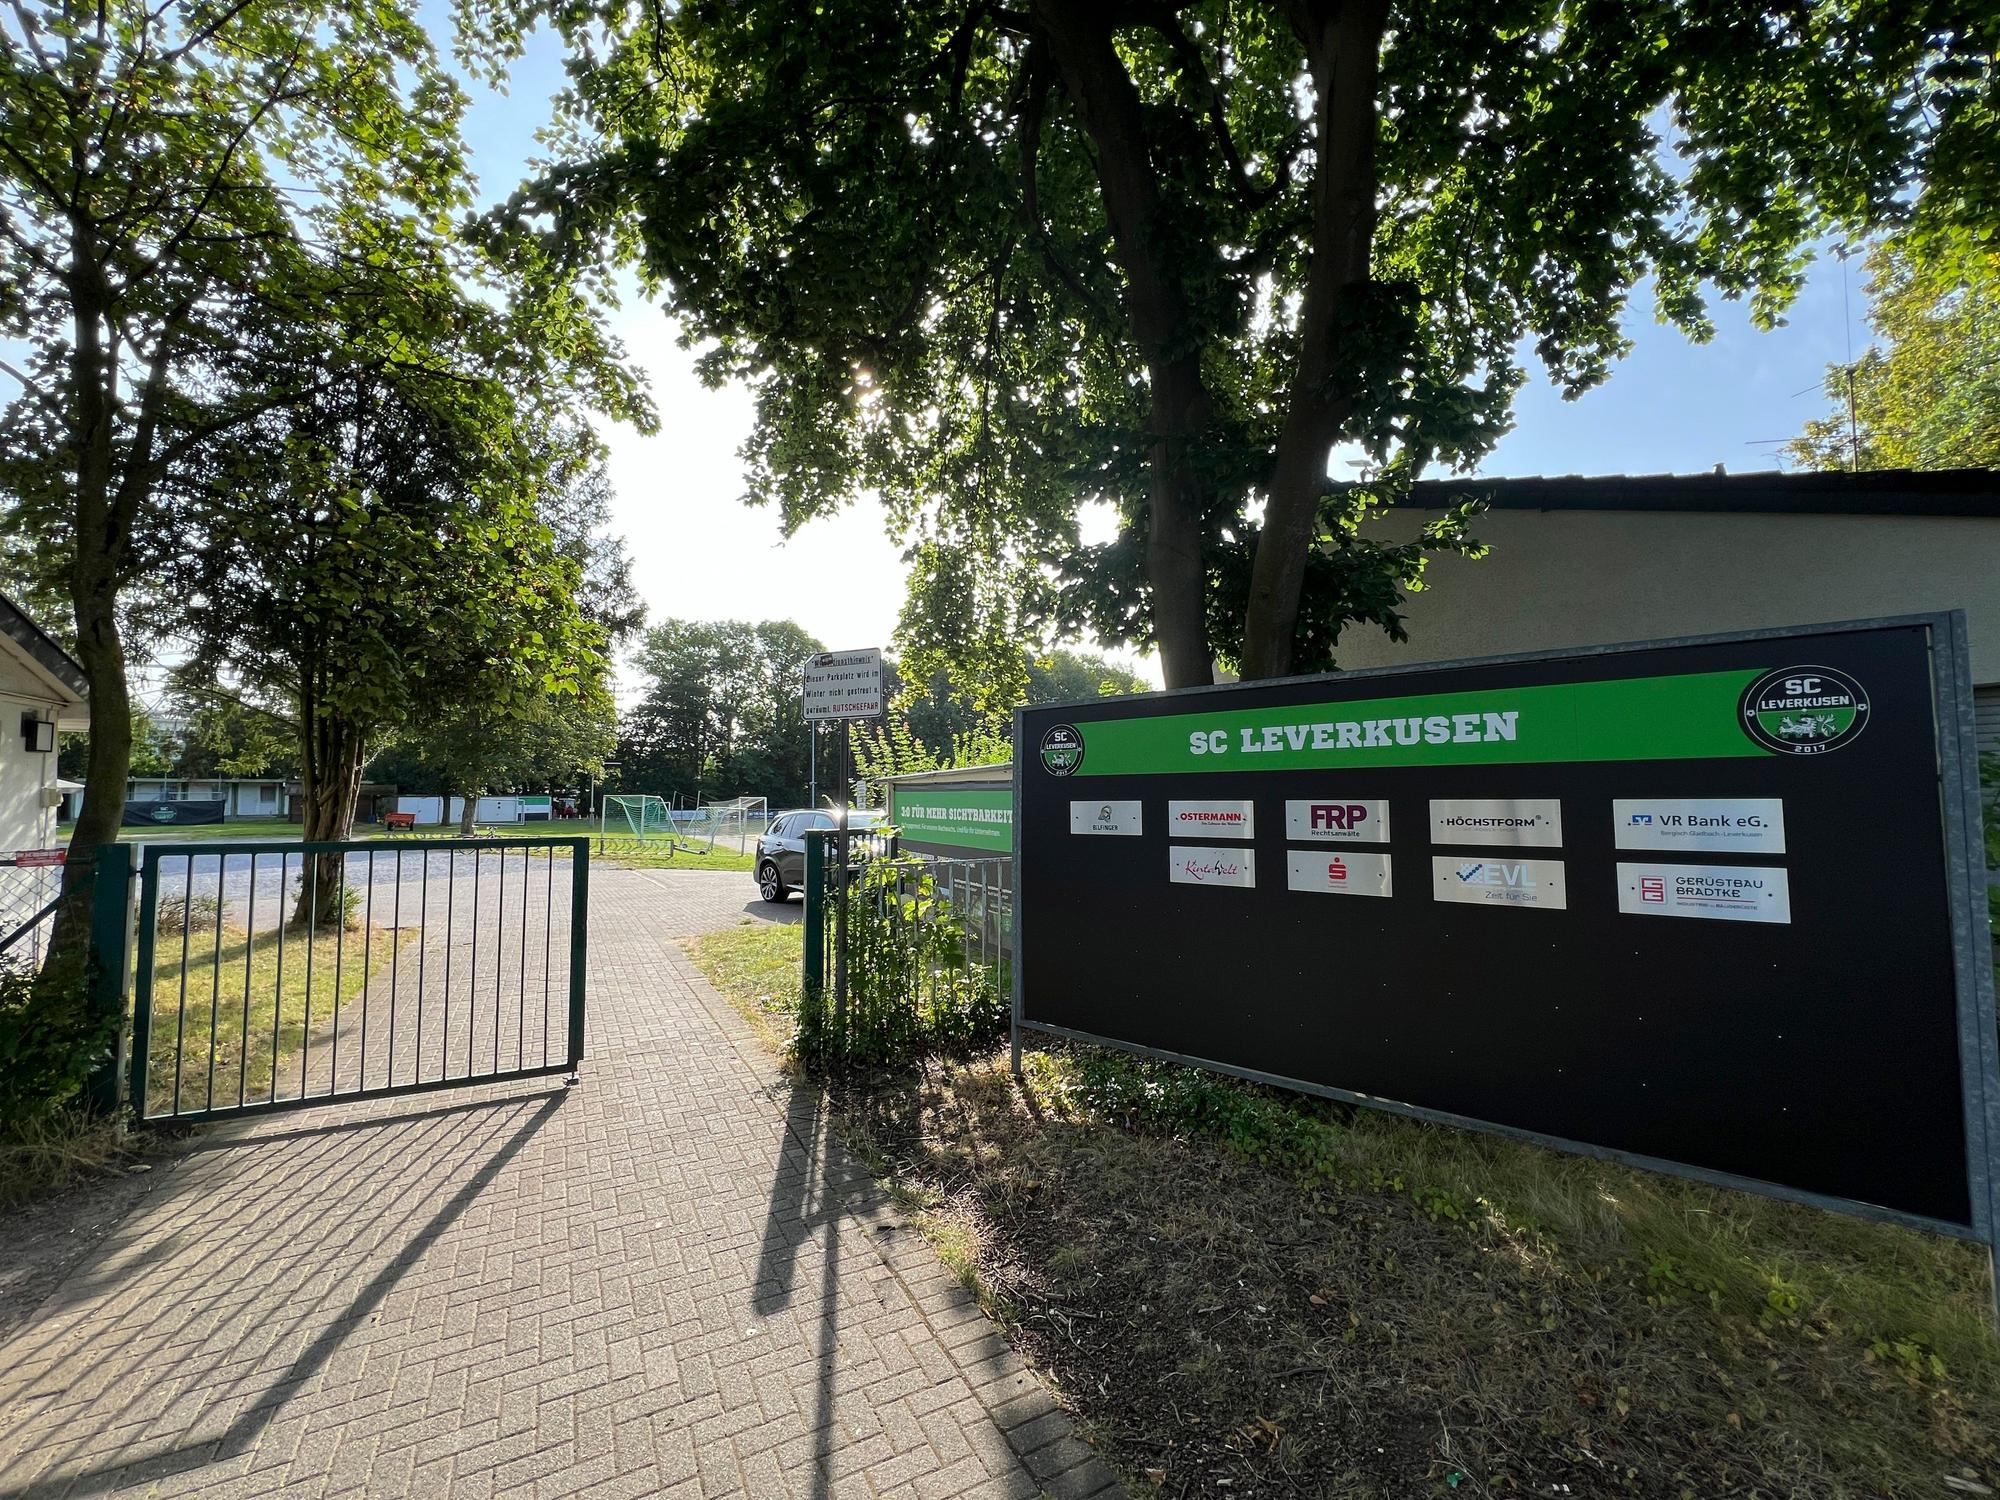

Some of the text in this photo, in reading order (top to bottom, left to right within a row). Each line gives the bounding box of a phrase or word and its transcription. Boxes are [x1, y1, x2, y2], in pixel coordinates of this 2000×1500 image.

[827, 672, 854, 681] Parkplatz
[857, 670, 870, 678] wird
[806, 690, 826, 698] Winter
[829, 688, 844, 696] nicht
[848, 686, 872, 697] gestreut
[1785, 678, 1822, 695] SC
[832, 702, 879, 713] RUTSCHGEFAHR
[1762, 696, 1850, 710] LEVERKUSEN
[1054, 732, 1068, 742] SC
[1189, 711, 1519, 754] SC LEVERKUSEN
[1794, 744, 1826, 753] 2017
[912, 804, 925, 818] FÜR
[926, 807, 948, 820] MEHR
[948, 808, 1012, 824] SICHTBARKEIT
[1180, 812, 1242, 821] OSTERMANN
[1310, 805, 1368, 830] FRP
[1446, 816, 1535, 827] HÖCHSTFORM
[1660, 814, 1760, 827] VR Bank eG
[1484, 864, 1536, 887] EVL
[1676, 876, 1764, 888] GERÜSTBAU
[1485, 891, 1538, 902] Zeit für Sie
[1676, 887, 1741, 898] BRADTKE
